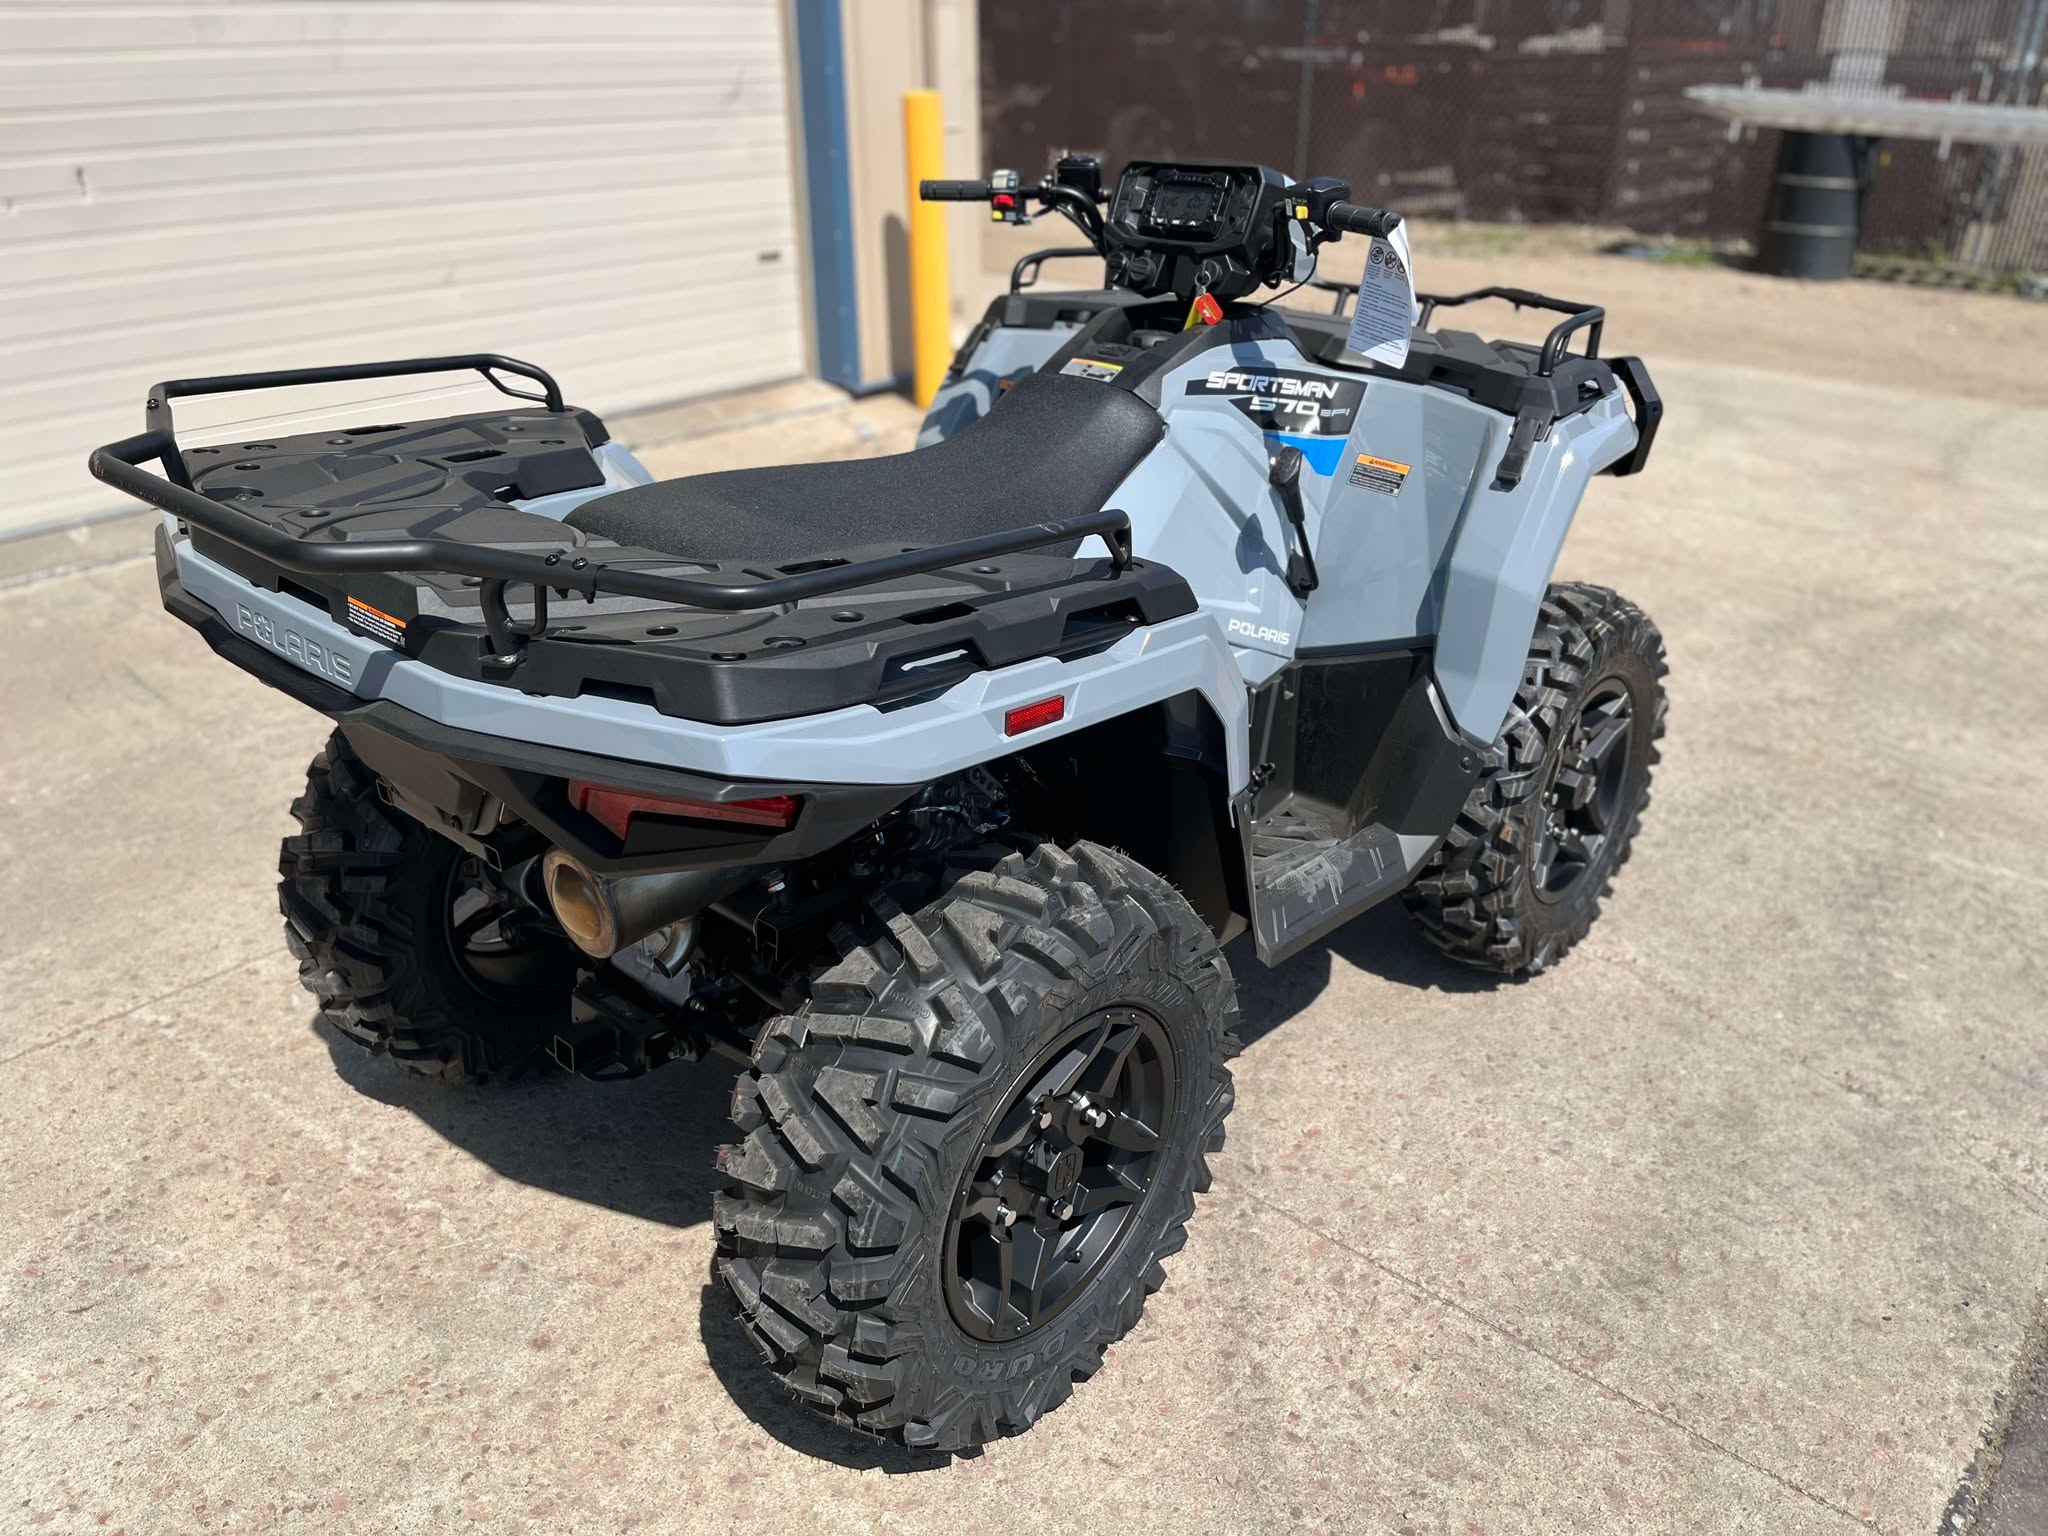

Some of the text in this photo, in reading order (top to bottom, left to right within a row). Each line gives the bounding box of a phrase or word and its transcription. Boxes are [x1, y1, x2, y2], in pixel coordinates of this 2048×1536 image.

[1205, 371, 1340, 399] SPORTSMAN
[1249, 396, 1320, 415] 570
[236, 602, 353, 685] POLARIS
[1228, 618, 1291, 646] POLARIS
[954, 1329, 1068, 1380] DURO
